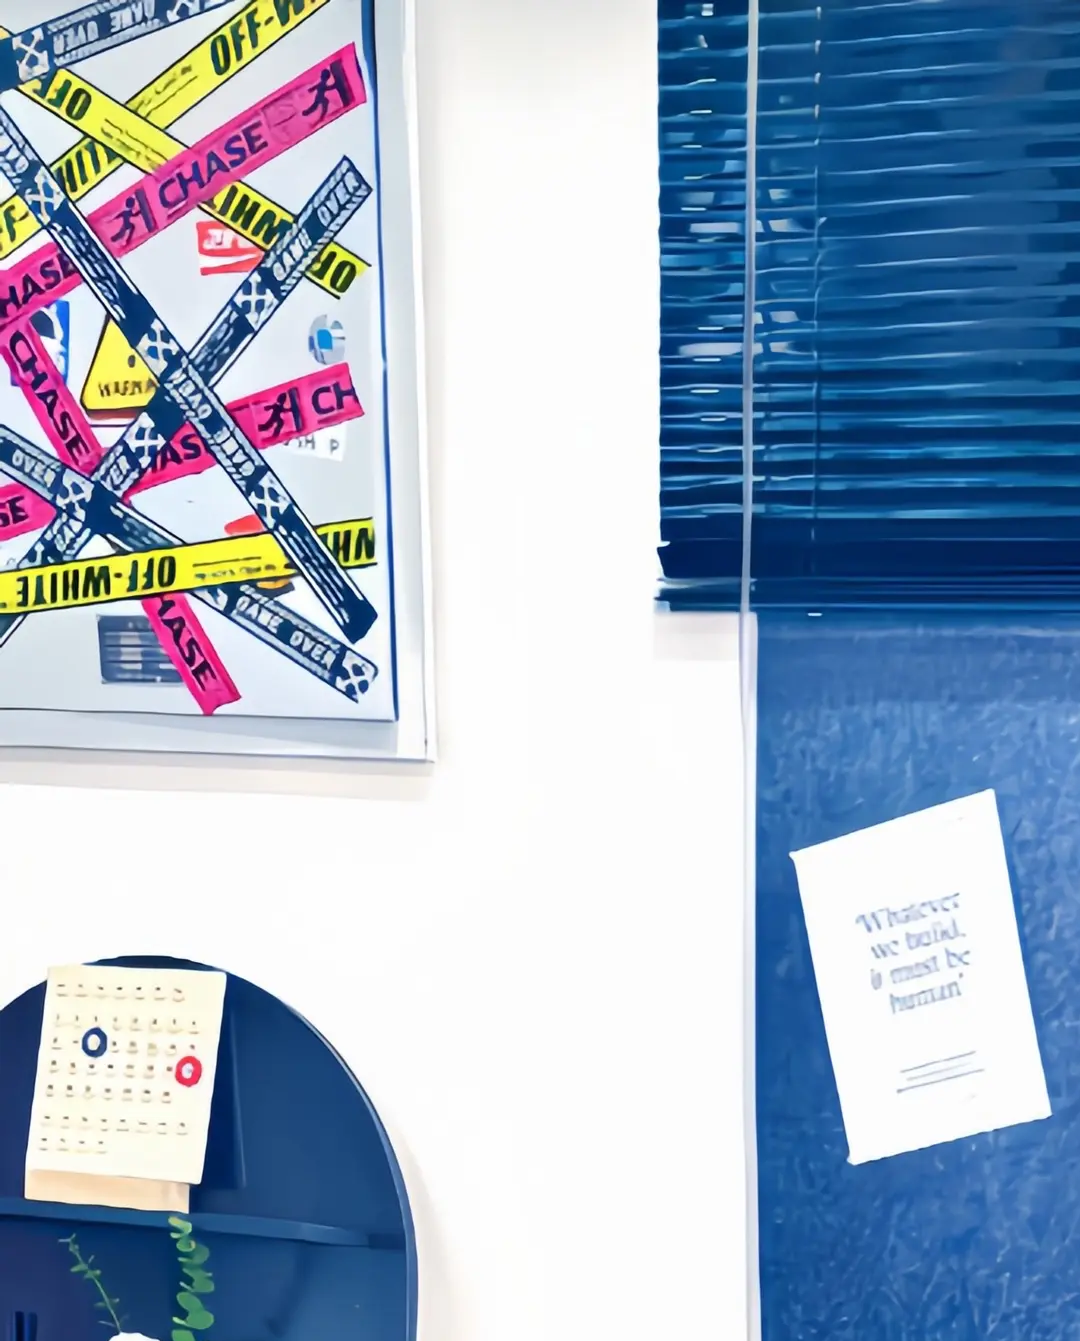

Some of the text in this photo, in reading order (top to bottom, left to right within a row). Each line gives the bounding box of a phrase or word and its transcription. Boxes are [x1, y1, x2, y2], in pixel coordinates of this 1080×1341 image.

[210, 0, 320, 76] OFF-W
[158, 120, 269, 209] CHASE
[0, 251, 79, 318] HASE
[9, 330, 91, 467] CHASE
[16, 556, 177, 607] OFF-WHITE
[157, 599, 217, 692] HASE
